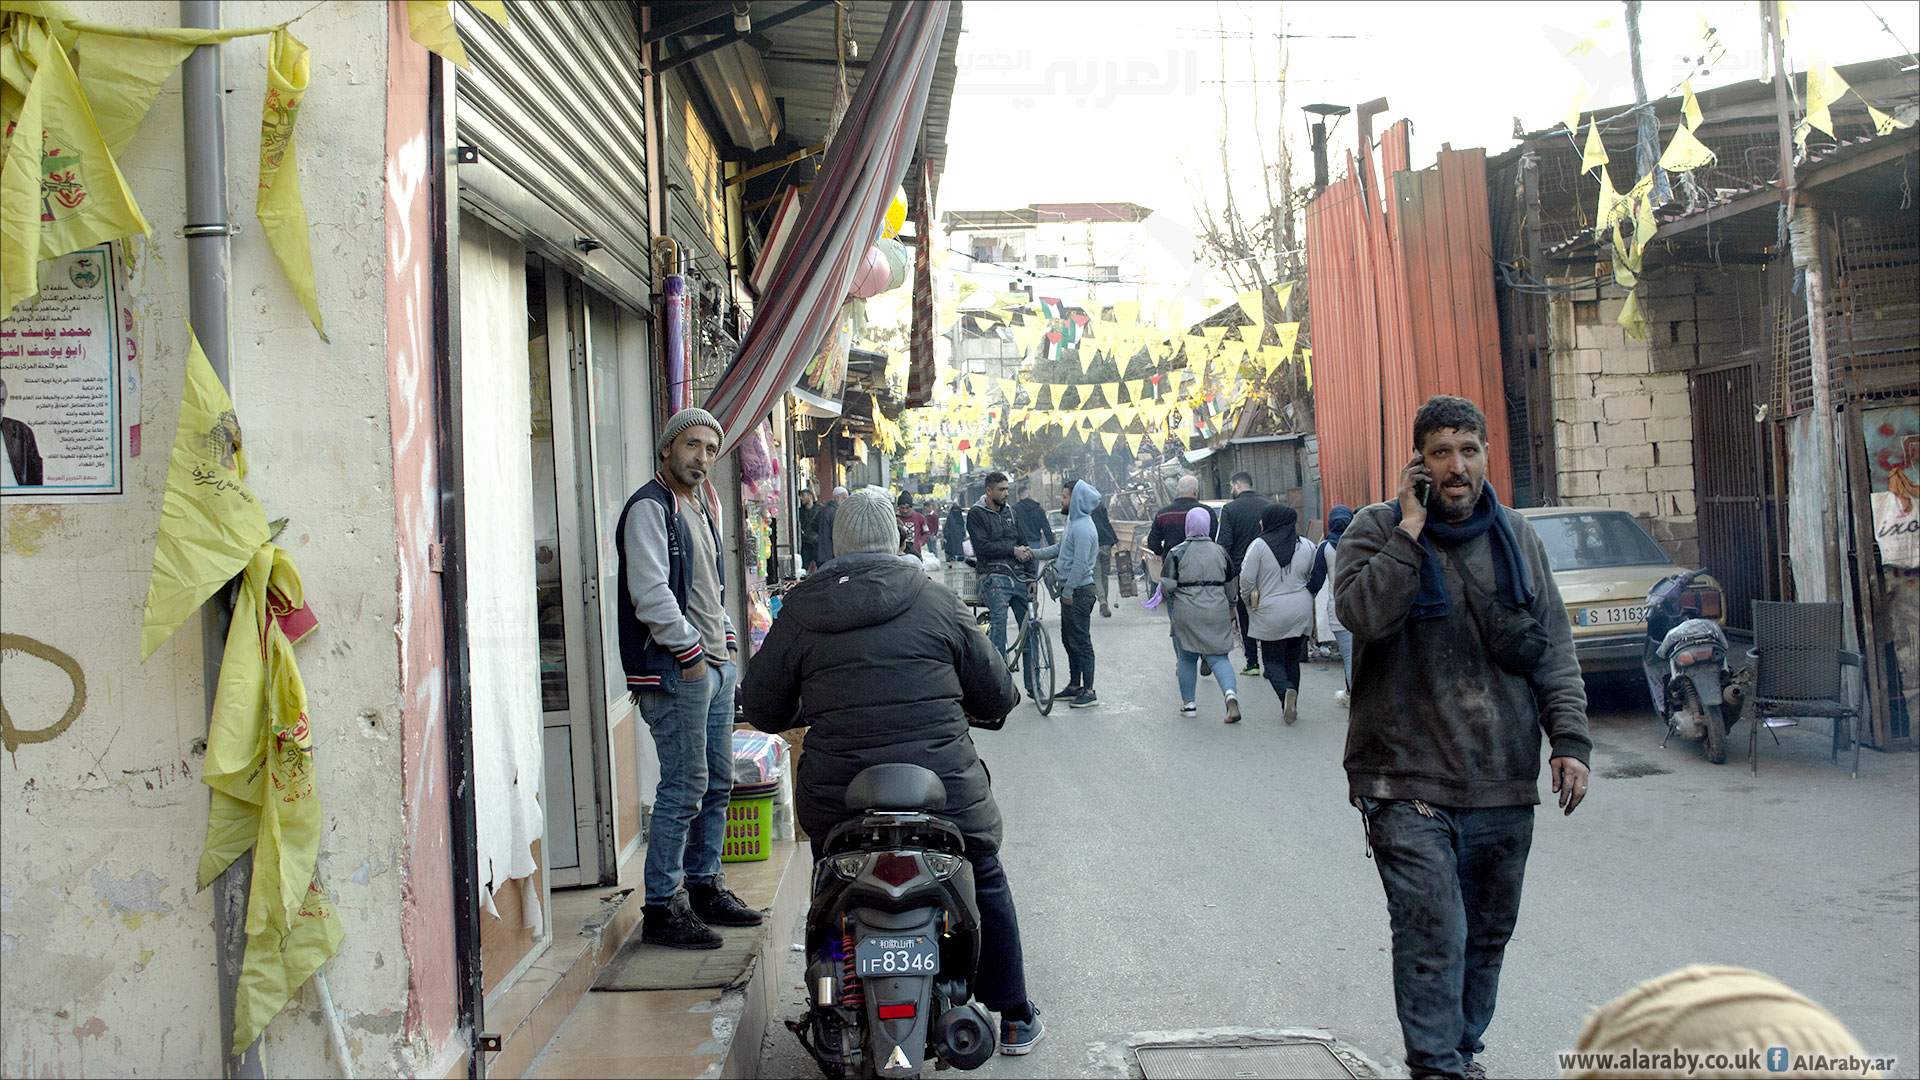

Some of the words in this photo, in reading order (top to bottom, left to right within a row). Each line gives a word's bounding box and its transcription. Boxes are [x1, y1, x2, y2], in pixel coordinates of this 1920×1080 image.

[41, 294, 60, 302] الاشتر
[60, 294, 77, 303] العربي
[76, 293, 92, 301] البعث
[91, 293, 105, 301] حزب
[50, 314, 72, 322] الشهيد
[21, 325, 57, 341] يوسف
[59, 327, 93, 338] محمد
[27, 343, 63, 360] يوسف
[14, 362, 38, 371] المركزية
[38, 362, 55, 370] اللجنة
[1589, 609, 1599, 624] S
